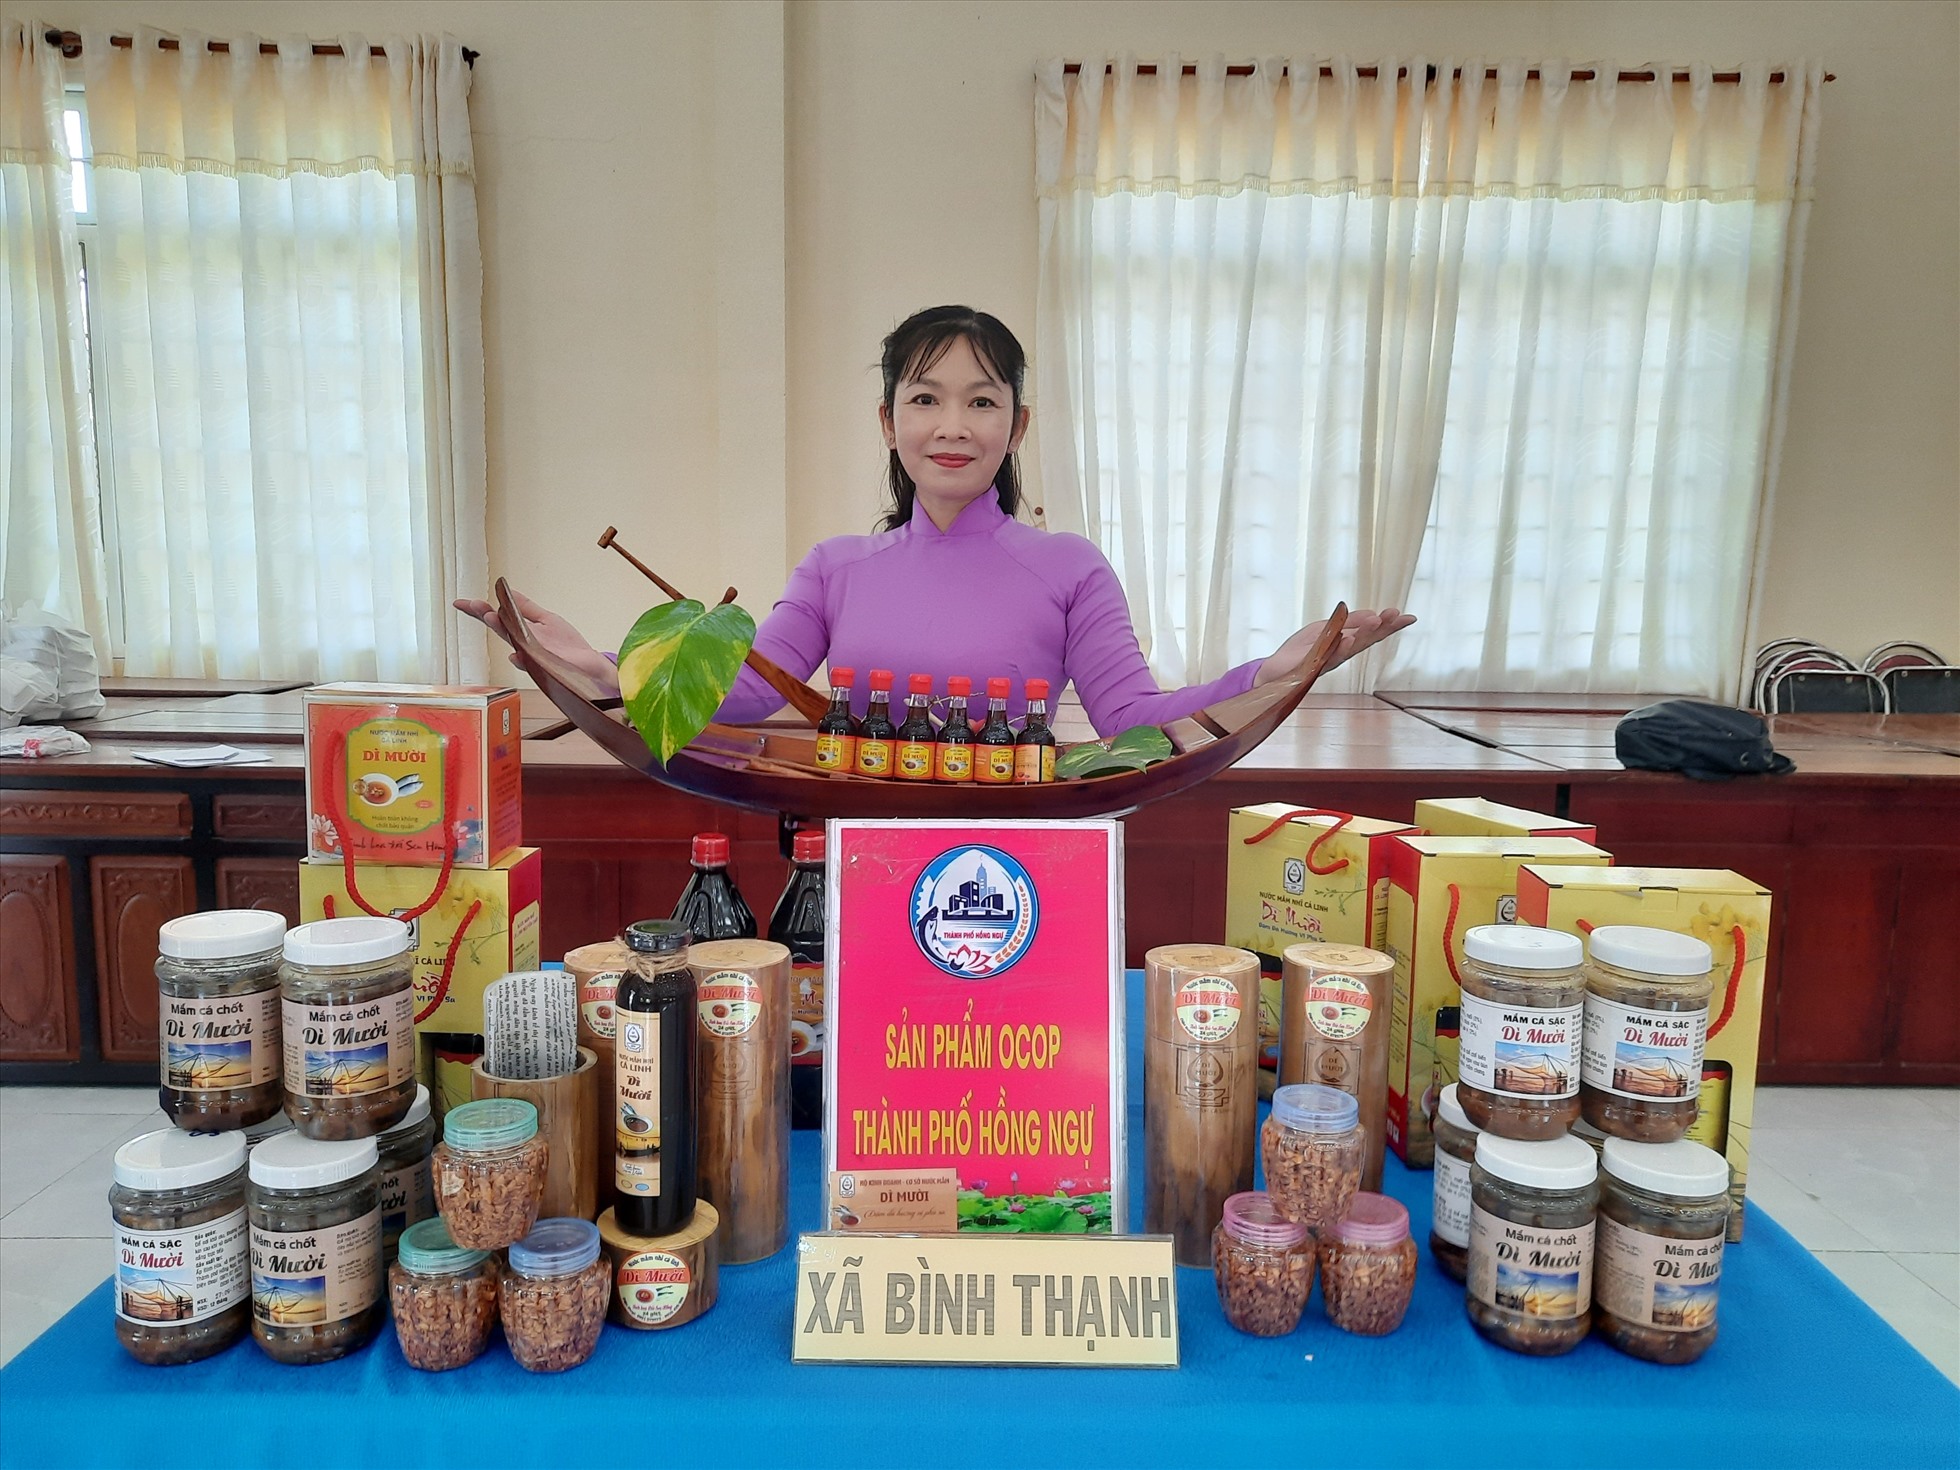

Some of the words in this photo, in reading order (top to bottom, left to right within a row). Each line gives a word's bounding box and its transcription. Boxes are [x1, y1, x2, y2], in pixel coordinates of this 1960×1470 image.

[363, 748, 380, 761] DÌ
[385, 749, 426, 763] MƯỜI
[1260, 891, 1276, 900] NƯỚC
[1277, 895, 1290, 903] MẮM
[1304, 900, 1311, 909] CÁ
[1314, 904, 1328, 912] LINH
[944, 931, 962, 939] THÀNH
[963, 930, 974, 939] PHỐ
[975, 930, 990, 939] HỒNG
[992, 931, 1004, 940] NGỰ
[421, 956, 432, 965] CÁ
[171, 1002, 196, 1015] Mắm
[200, 1005, 213, 1015] cá
[216, 1001, 243, 1015] chốt
[309, 1010, 336, 1022] Mắm
[340, 1011, 354, 1021] cá
[357, 1004, 380, 1020] chốt
[166, 1019, 186, 1038] Dì
[193, 1018, 253, 1038] Mười
[1503, 1013, 1528, 1024] MẮM
[1531, 1016, 1544, 1025] CÁ
[1548, 1017, 1565, 1027] SẶC
[1626, 1015, 1651, 1026] MẮM
[1655, 1018, 1668, 1029] CÁ
[1672, 1020, 1689, 1031] SẶC
[302, 1026, 326, 1046] Dì
[333, 1020, 389, 1046] Mười
[885, 1006, 926, 1069] SẢN
[932, 997, 992, 1069] PHẨM
[998, 1024, 1061, 1070] OCOP
[1502, 1026, 1521, 1042] Dì
[1526, 1028, 1566, 1044] Mười
[1623, 1026, 1644, 1044] Dì
[1648, 1030, 1688, 1047] Mười
[620, 1061, 628, 1070] CÁ
[630, 1064, 651, 1072] LINH
[627, 1075, 640, 1086] Dì
[620, 1086, 652, 1100] Mười
[852, 1096, 922, 1155] THÀNH
[928, 1089, 973, 1156] PHỐ
[978, 1085, 1041, 1156] HỒNG
[1048, 1104, 1095, 1170] NGỰ
[880, 1189, 893, 1202] DÌ
[897, 1190, 929, 1202] MƯỜI
[121, 1235, 140, 1248] MẮM
[142, 1239, 156, 1249] CÁ
[160, 1239, 182, 1250] SẶC
[254, 1232, 271, 1248] Mắm
[273, 1239, 286, 1249] cá
[290, 1236, 316, 1249] chốt
[1505, 1228, 1534, 1244] Mắm
[1537, 1234, 1551, 1246] cá
[1554, 1233, 1577, 1246] chốt
[121, 1248, 136, 1266] Dì
[140, 1252, 184, 1268] Mười
[1496, 1242, 1521, 1263] Dì
[1529, 1250, 1582, 1268] Mười
[1664, 1244, 1694, 1257] Mắm
[1697, 1245, 1708, 1256] cá
[251, 1247, 264, 1269] Dì
[269, 1253, 328, 1273] Mười
[1653, 1259, 1682, 1278] Dì
[624, 1271, 639, 1282] Dì
[645, 1270, 684, 1282] Mười
[803, 1256, 865, 1333] XÃ
[885, 1257, 995, 1335] BÌNH
[1012, 1274, 1171, 1351] THẠNH
